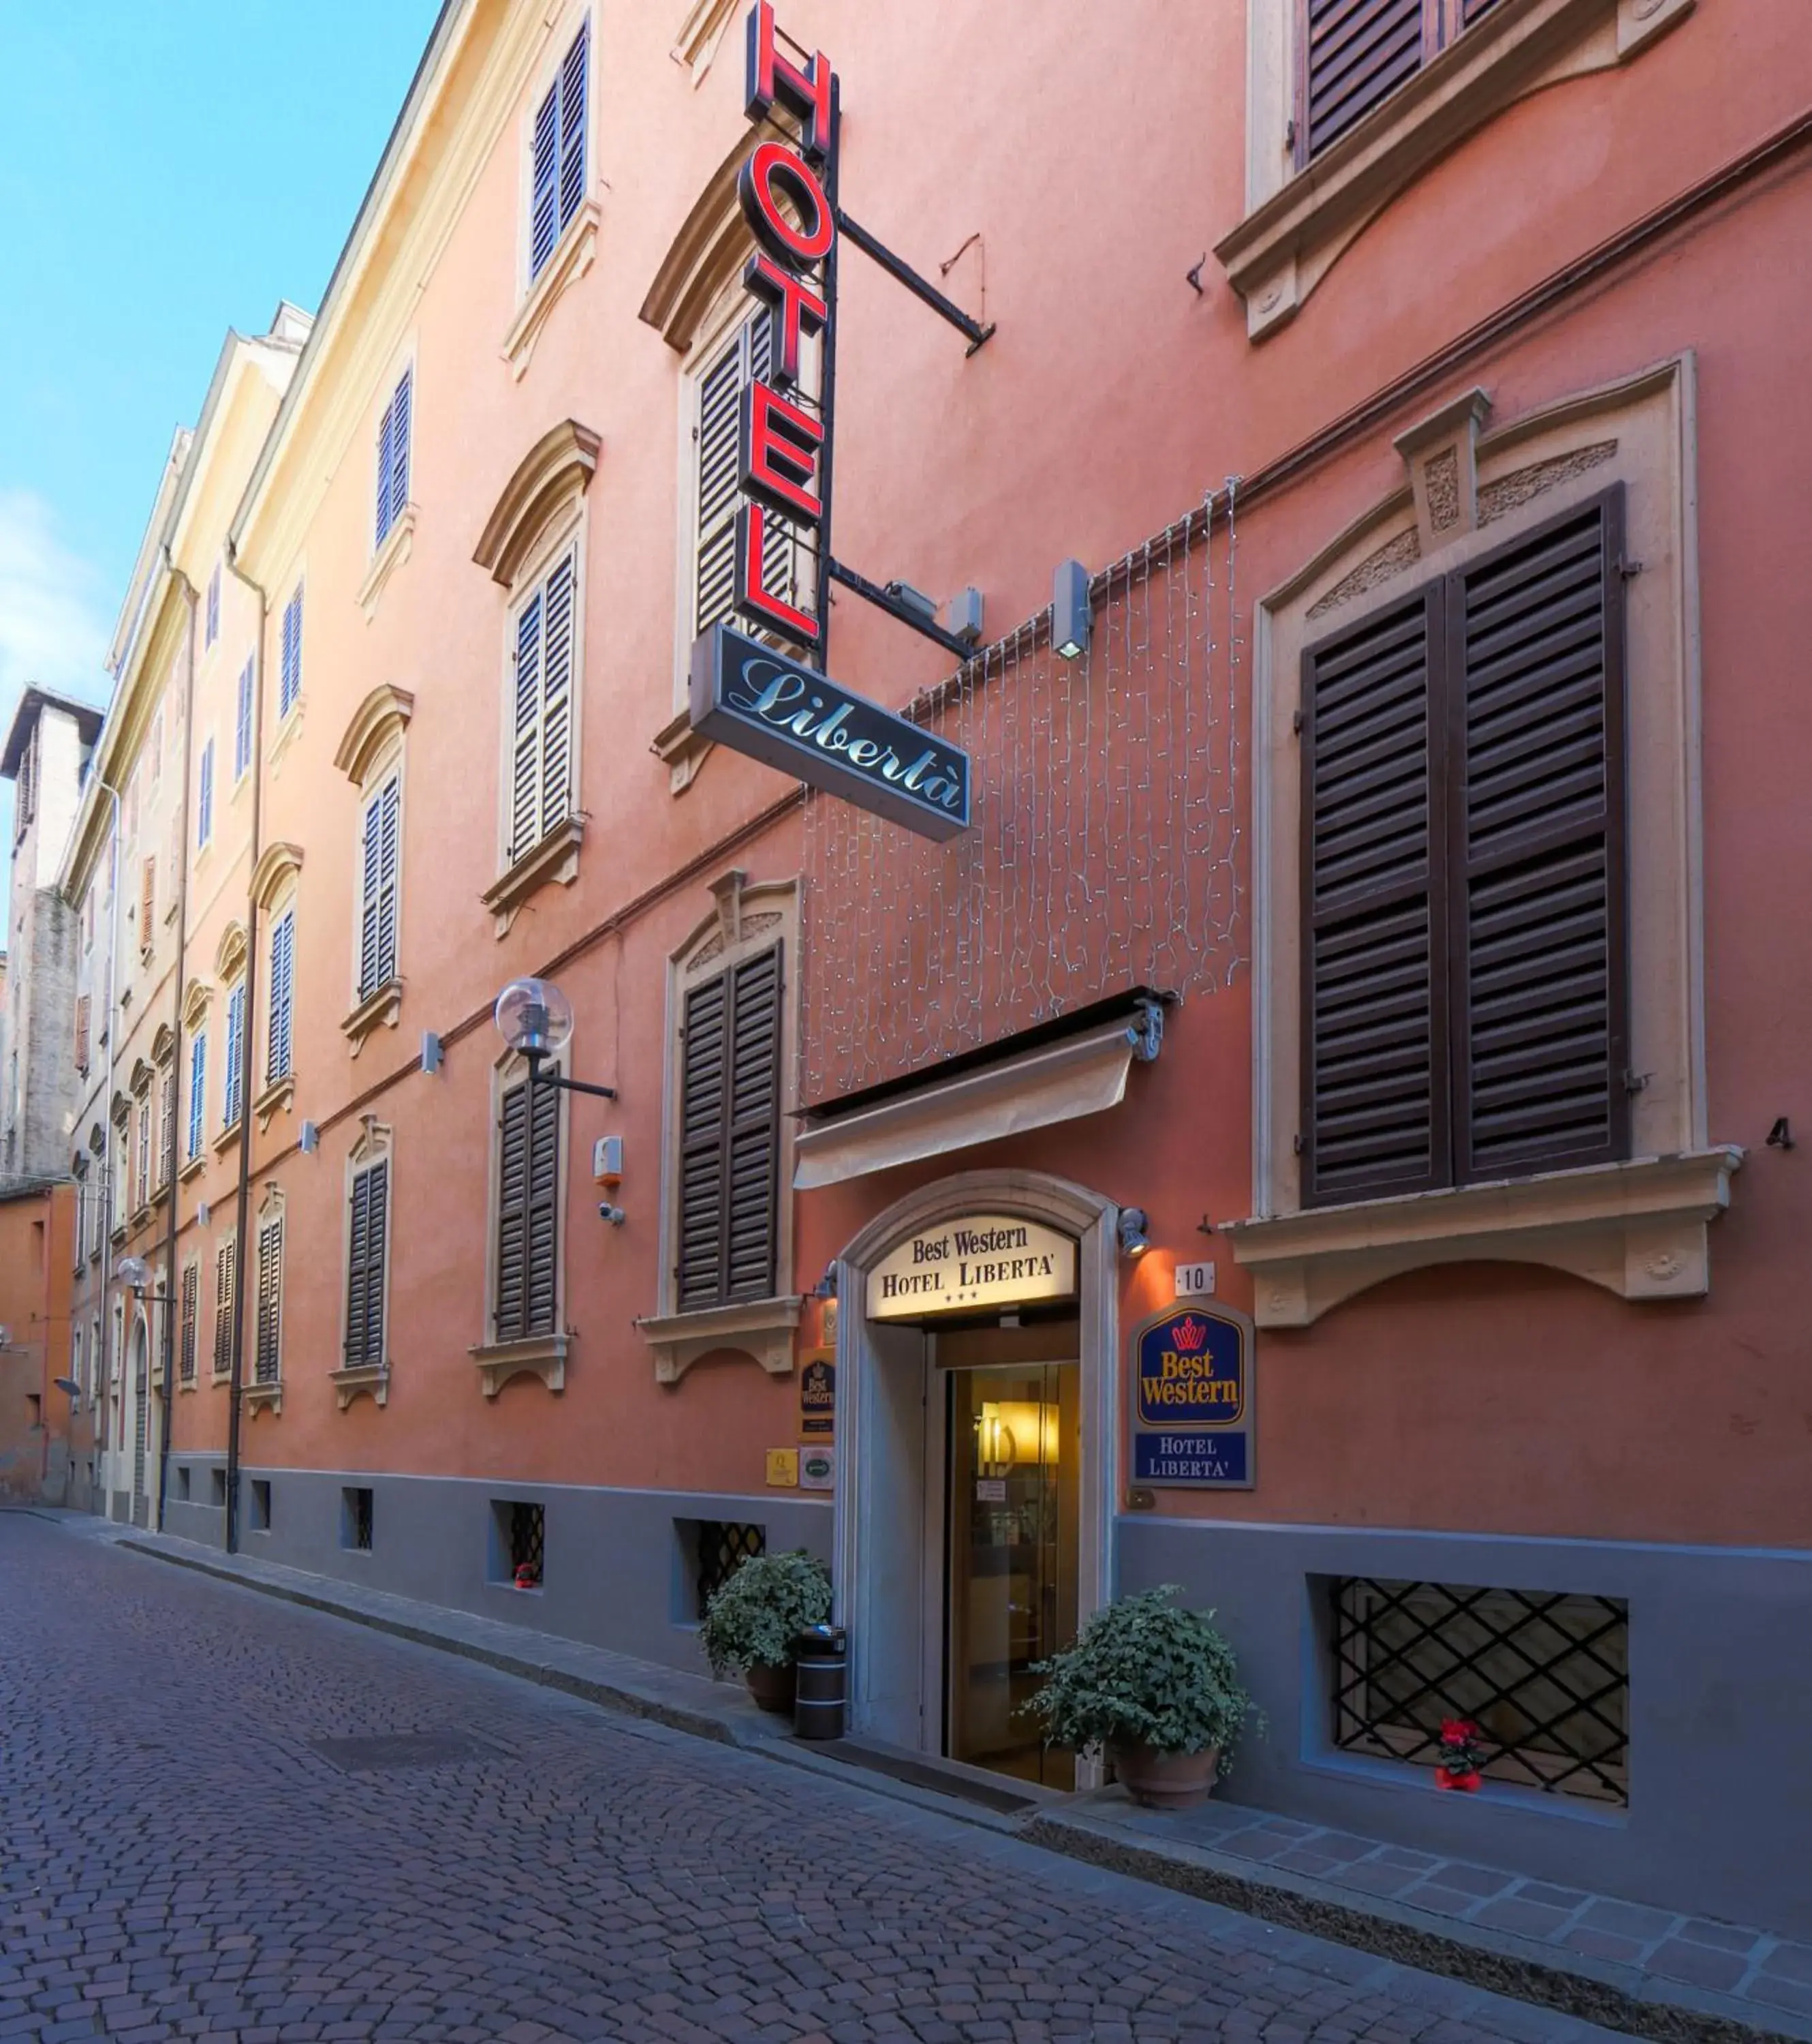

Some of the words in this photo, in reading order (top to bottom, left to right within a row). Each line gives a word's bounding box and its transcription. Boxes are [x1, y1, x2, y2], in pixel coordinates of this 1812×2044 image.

[740, 0, 834, 642] HOTEL
[728, 656, 960, 809] Libertà
[912, 1235, 950, 1264] Best
[954, 1226, 1028, 1257] Western
[882, 1272, 945, 1299] HOTEL
[1185, 1267, 1204, 1290] 10
[1161, 1348, 1215, 1380] Best
[1142, 1376, 1238, 1406] Western
[1159, 1436, 1217, 1455] HOTEL
